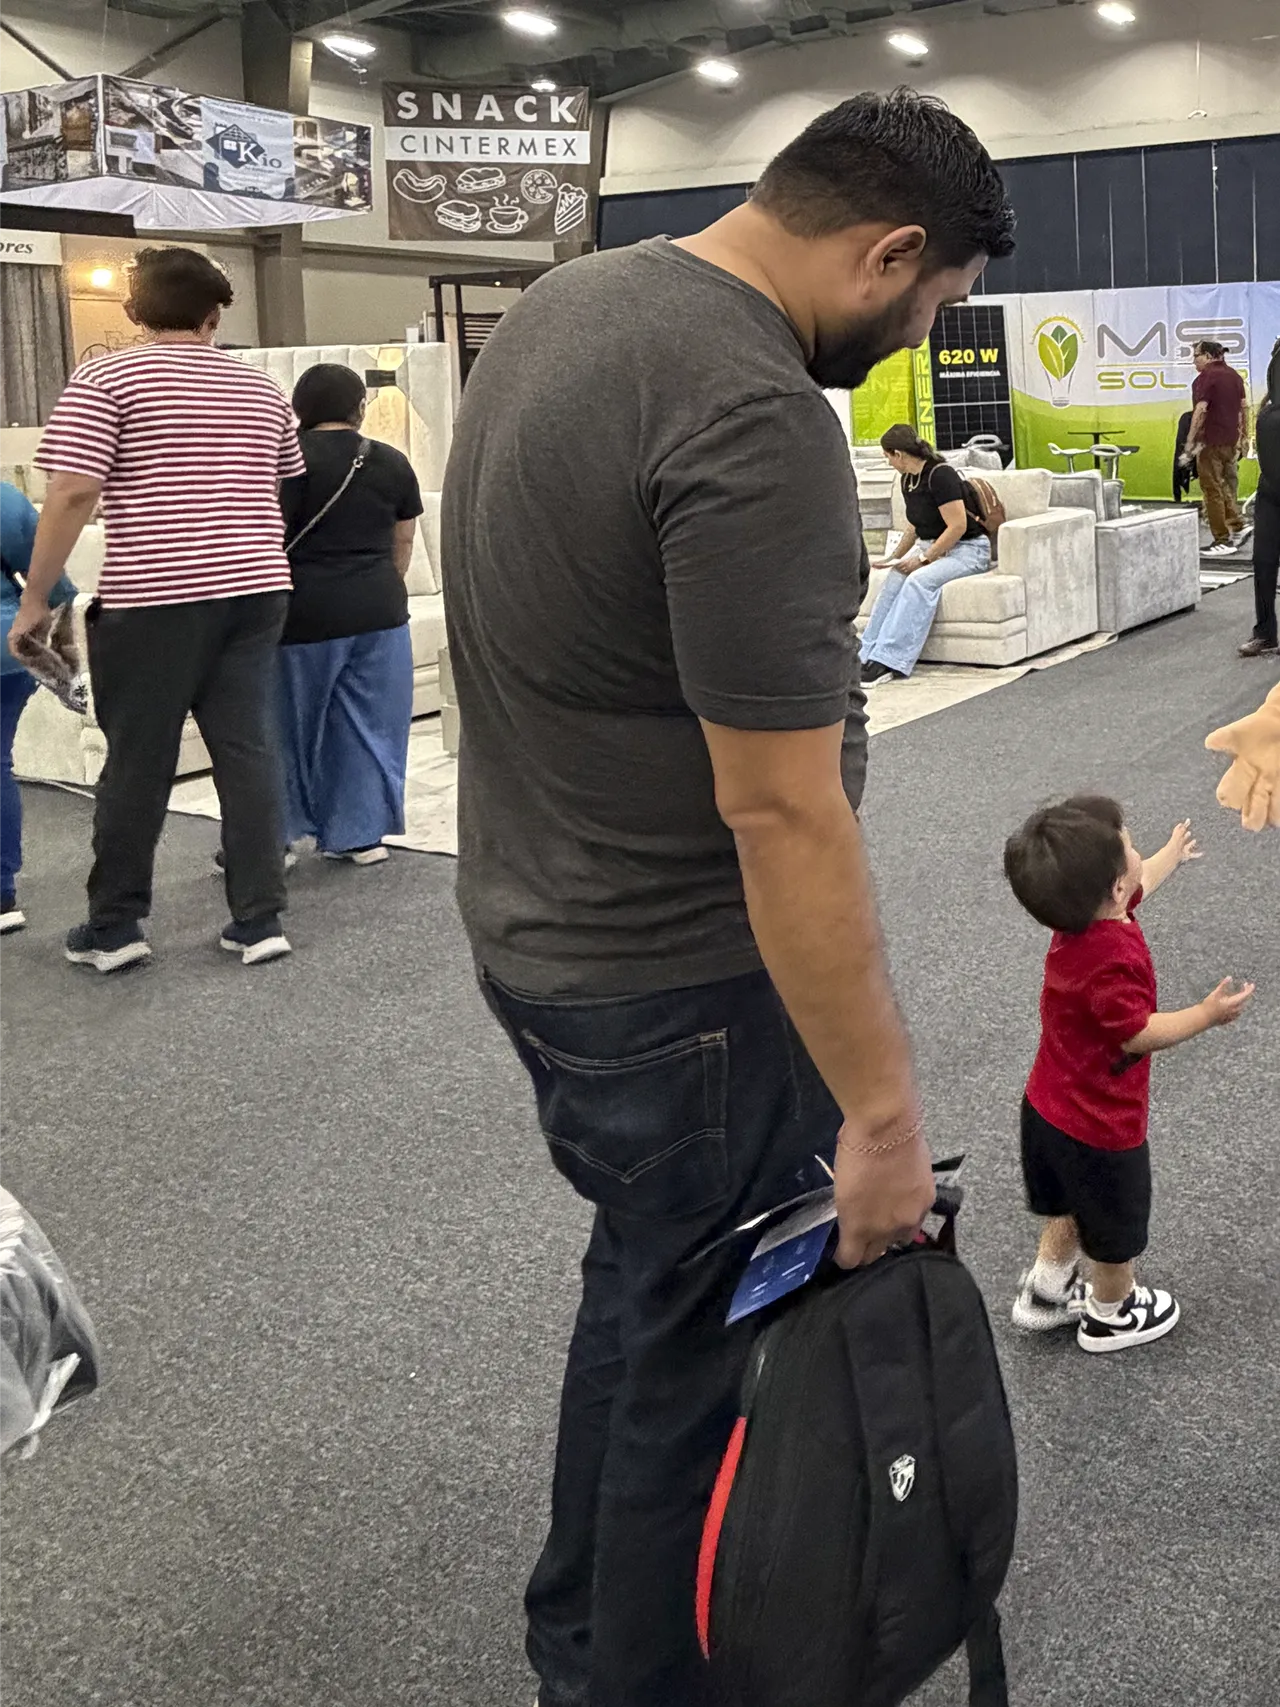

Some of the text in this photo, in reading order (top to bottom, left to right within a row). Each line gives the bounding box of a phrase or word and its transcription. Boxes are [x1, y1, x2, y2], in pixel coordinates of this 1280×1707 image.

[397, 91, 577, 123] SNACK
[237, 141, 282, 169] Kio
[400, 135, 577, 156] CINTERMEX
[1097, 318, 1246, 358] MS
[939, 348, 999, 365] 620 W
[1097, 368, 1250, 391] SOL
